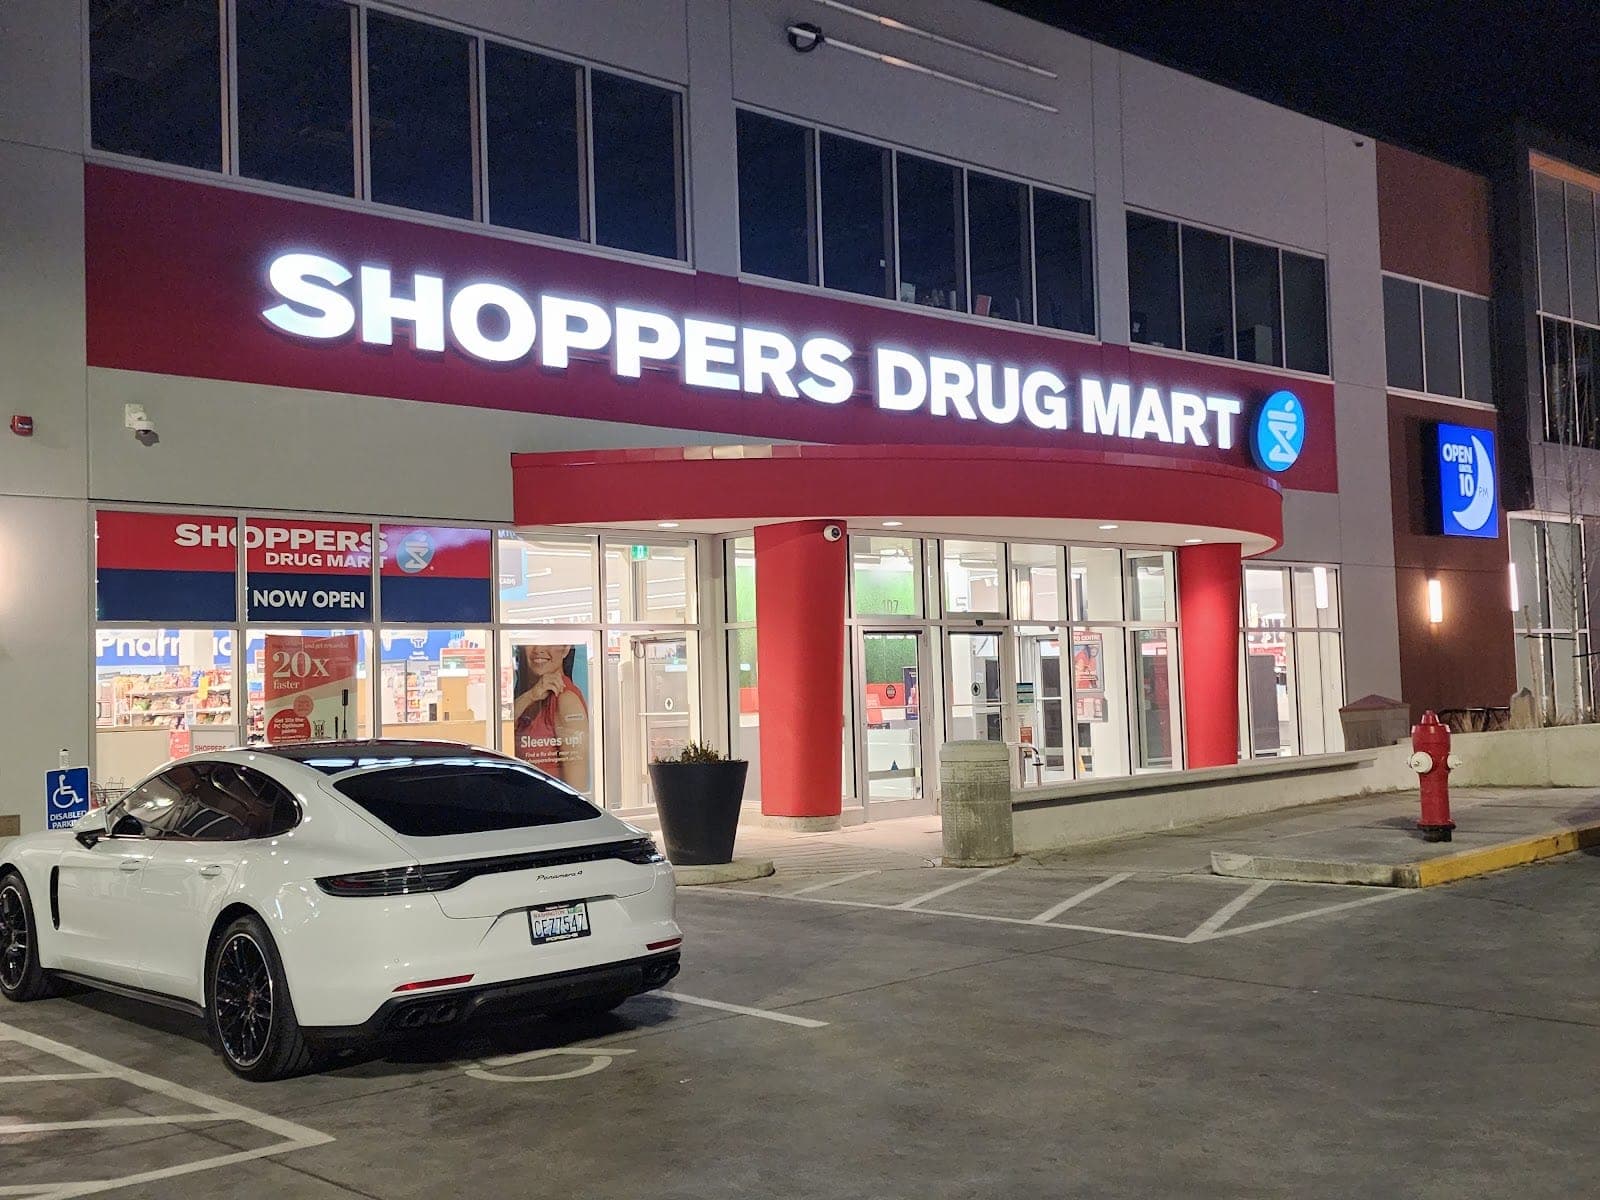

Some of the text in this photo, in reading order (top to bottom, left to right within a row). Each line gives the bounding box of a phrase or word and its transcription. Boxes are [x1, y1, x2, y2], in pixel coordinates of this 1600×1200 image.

[262, 253, 1241, 450] SHOPPERS DRUG MART
[1442, 443, 1473, 465] OPEN
[1459, 473, 1475, 497] 10
[1478, 487, 1489, 497] PM
[174, 523, 388, 553] SHOPPERS
[265, 552, 388, 569] DRUG MART
[253, 590, 365, 609] NOW OPEN
[272, 651, 330, 678] 20x
[273, 680, 300, 690] faster
[520, 735, 563, 748] Sleeves
[50, 810, 87, 821] DISABLED
[52, 819, 75, 830] PARKI
[536, 873, 576, 881] Panamera
